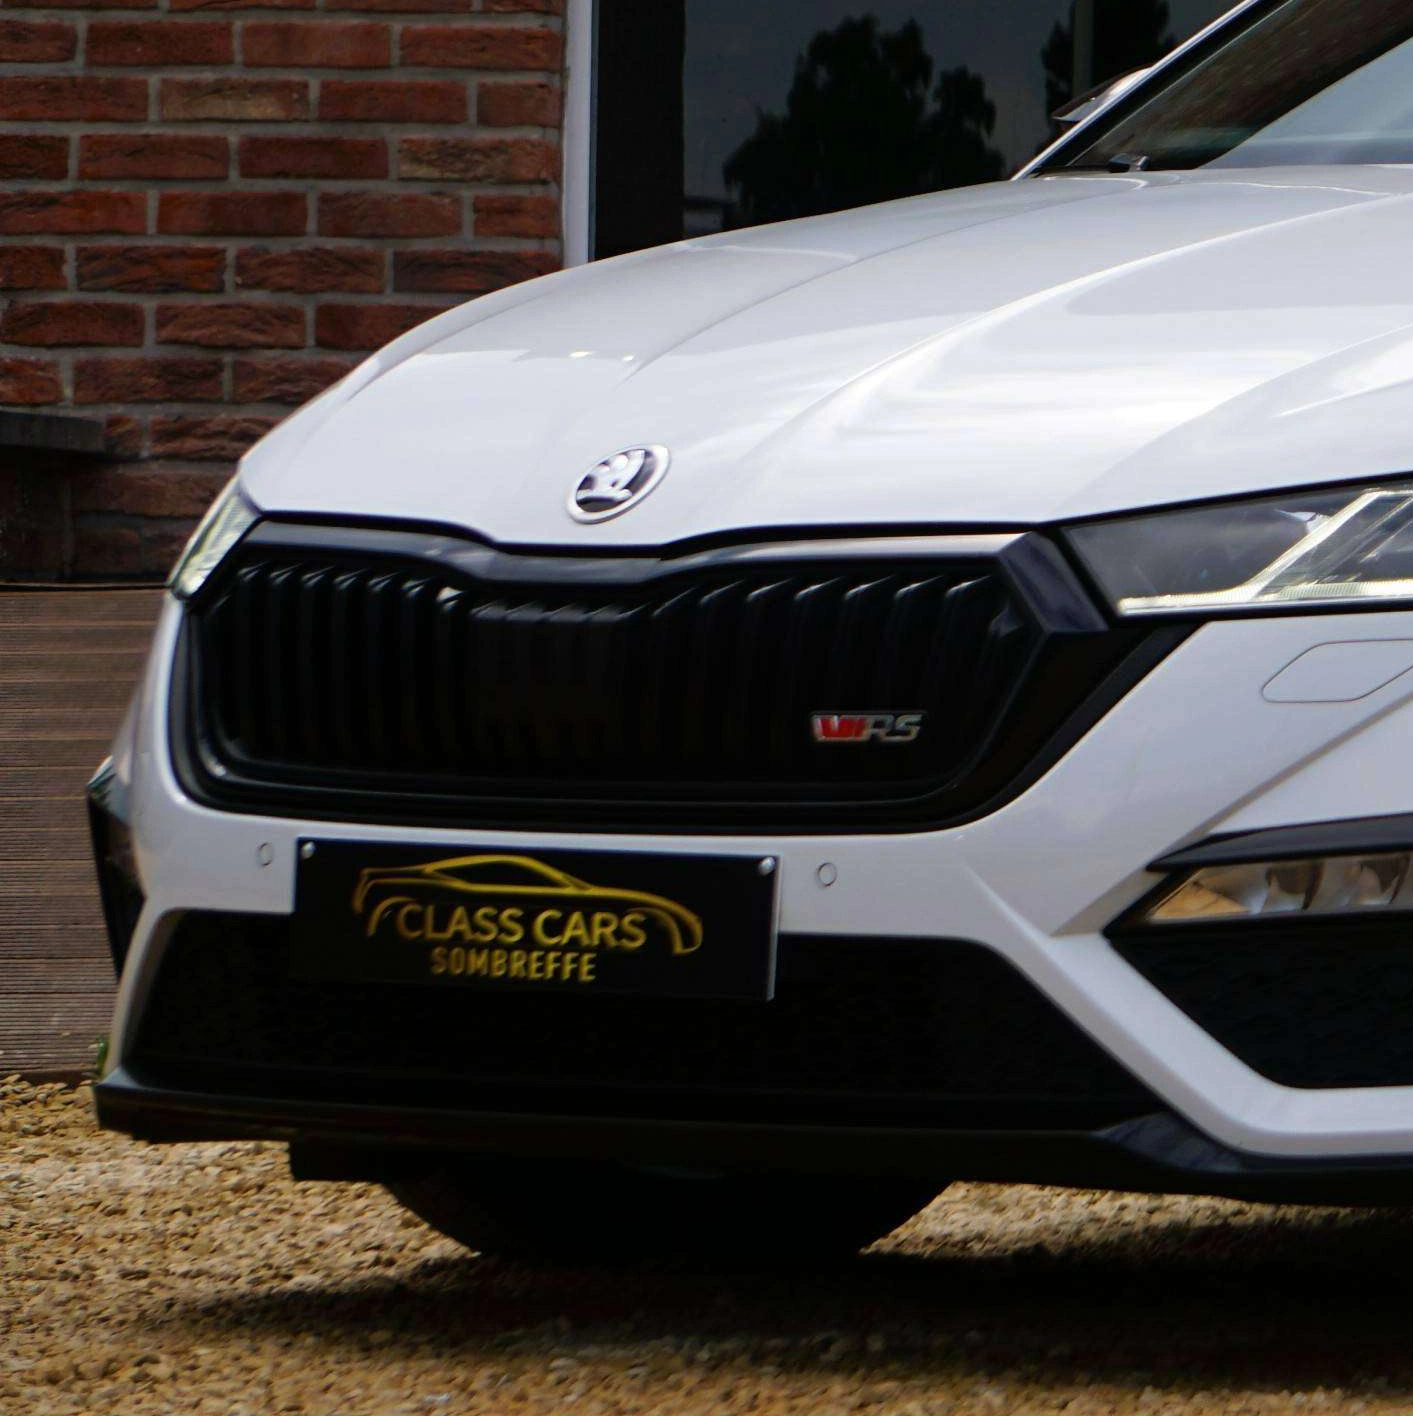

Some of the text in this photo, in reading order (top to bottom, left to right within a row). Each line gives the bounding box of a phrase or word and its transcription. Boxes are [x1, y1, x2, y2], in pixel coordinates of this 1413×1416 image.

[396, 903, 648, 949] CLASS CARS
[430, 945, 598, 982] SOMBREFFE
